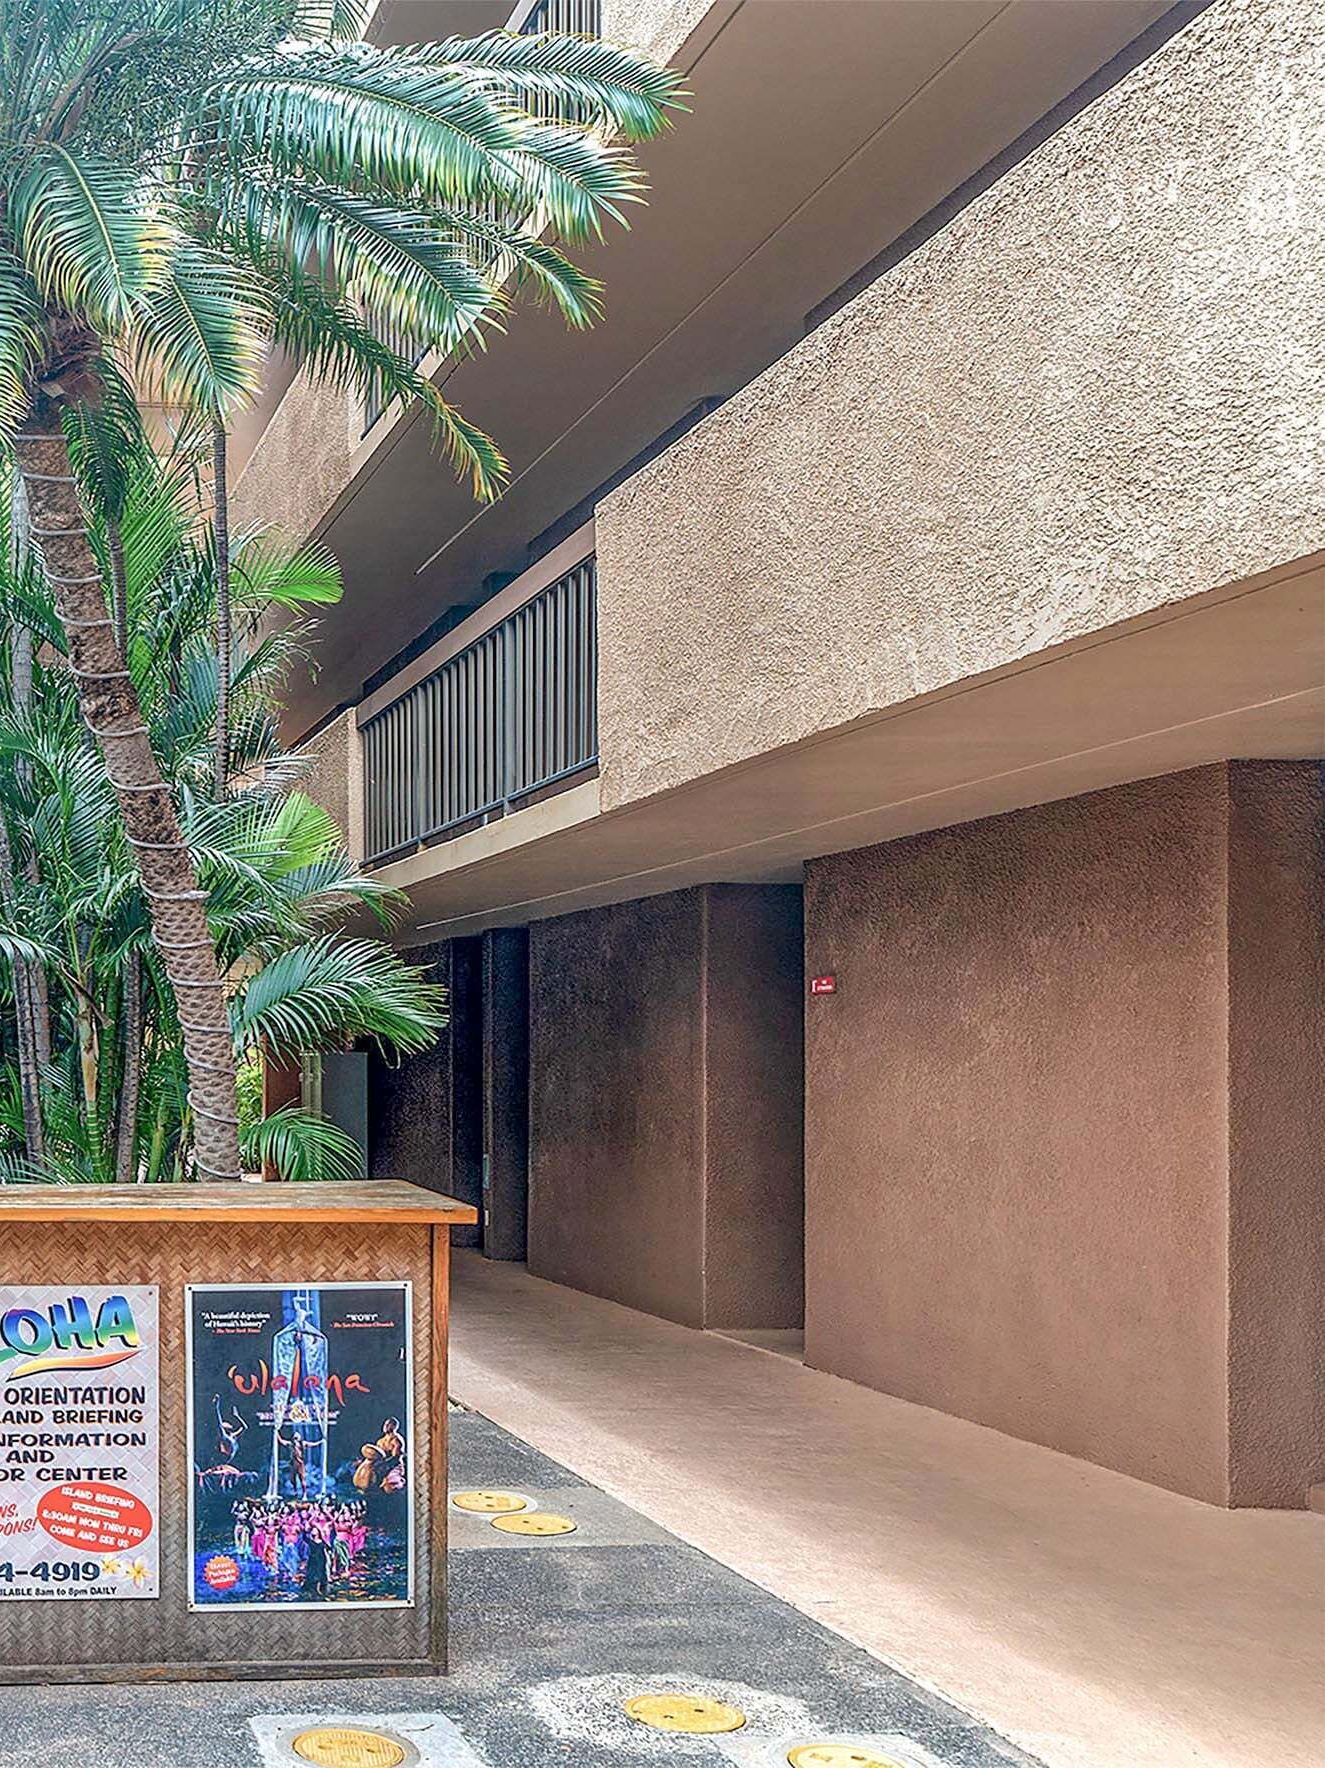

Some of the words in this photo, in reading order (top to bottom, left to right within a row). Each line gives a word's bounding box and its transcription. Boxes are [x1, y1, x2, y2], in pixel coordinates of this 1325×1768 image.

[211, 1311, 239, 1319] beautiful
[240, 1312, 271, 1320] depiction
[204, 1320, 212, 1328] of
[3, 1386, 146, 1405] ORIENTATION
[52, 1409, 144, 1424] BRIEFING
[6, 1450, 55, 1464] AND
[36, 1467, 128, 1481] CENTER
[61, 1486, 94, 1500] ISLAND
[95, 1493, 135, 1509] BRIEFING
[78, 1517, 101, 1529] MON
[103, 1521, 126, 1534] THRU
[127, 1527, 143, 1538] FRI
[49, 1525, 75, 1537] COME
[77, 1530, 97, 1542] AND
[98, 1534, 115, 1546] SEE
[117, 1539, 130, 1548] US
[35, 1588, 55, 1596] 8am
[56, 1588, 66, 1596] to
[68, 1588, 88, 1597] 8pm
[90, 1586, 117, 1595] DAILY
